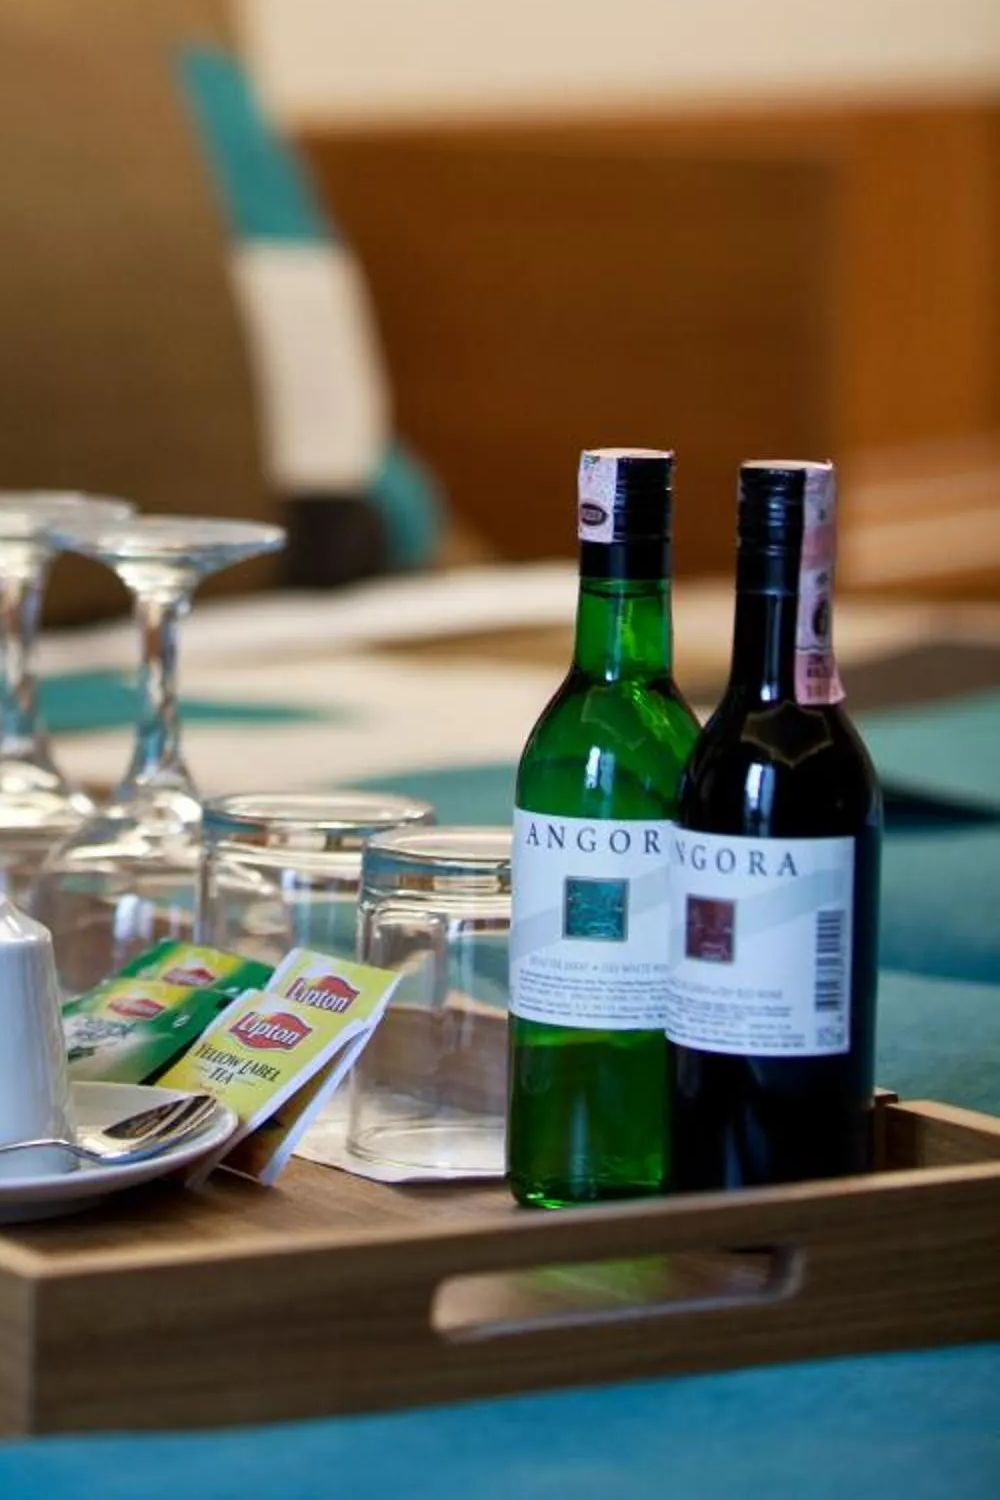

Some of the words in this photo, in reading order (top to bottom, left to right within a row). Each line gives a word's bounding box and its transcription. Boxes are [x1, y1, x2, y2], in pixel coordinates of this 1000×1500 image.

[526, 822, 661, 854] ANGOR
[674, 839, 798, 876] NGORA
[291, 979, 348, 1012] Lipton
[239, 1013, 300, 1046] Lipton
[195, 1043, 242, 1067] YELLOW
[237, 1059, 281, 1082] LABEL
[208, 1067, 235, 1085] TEA
